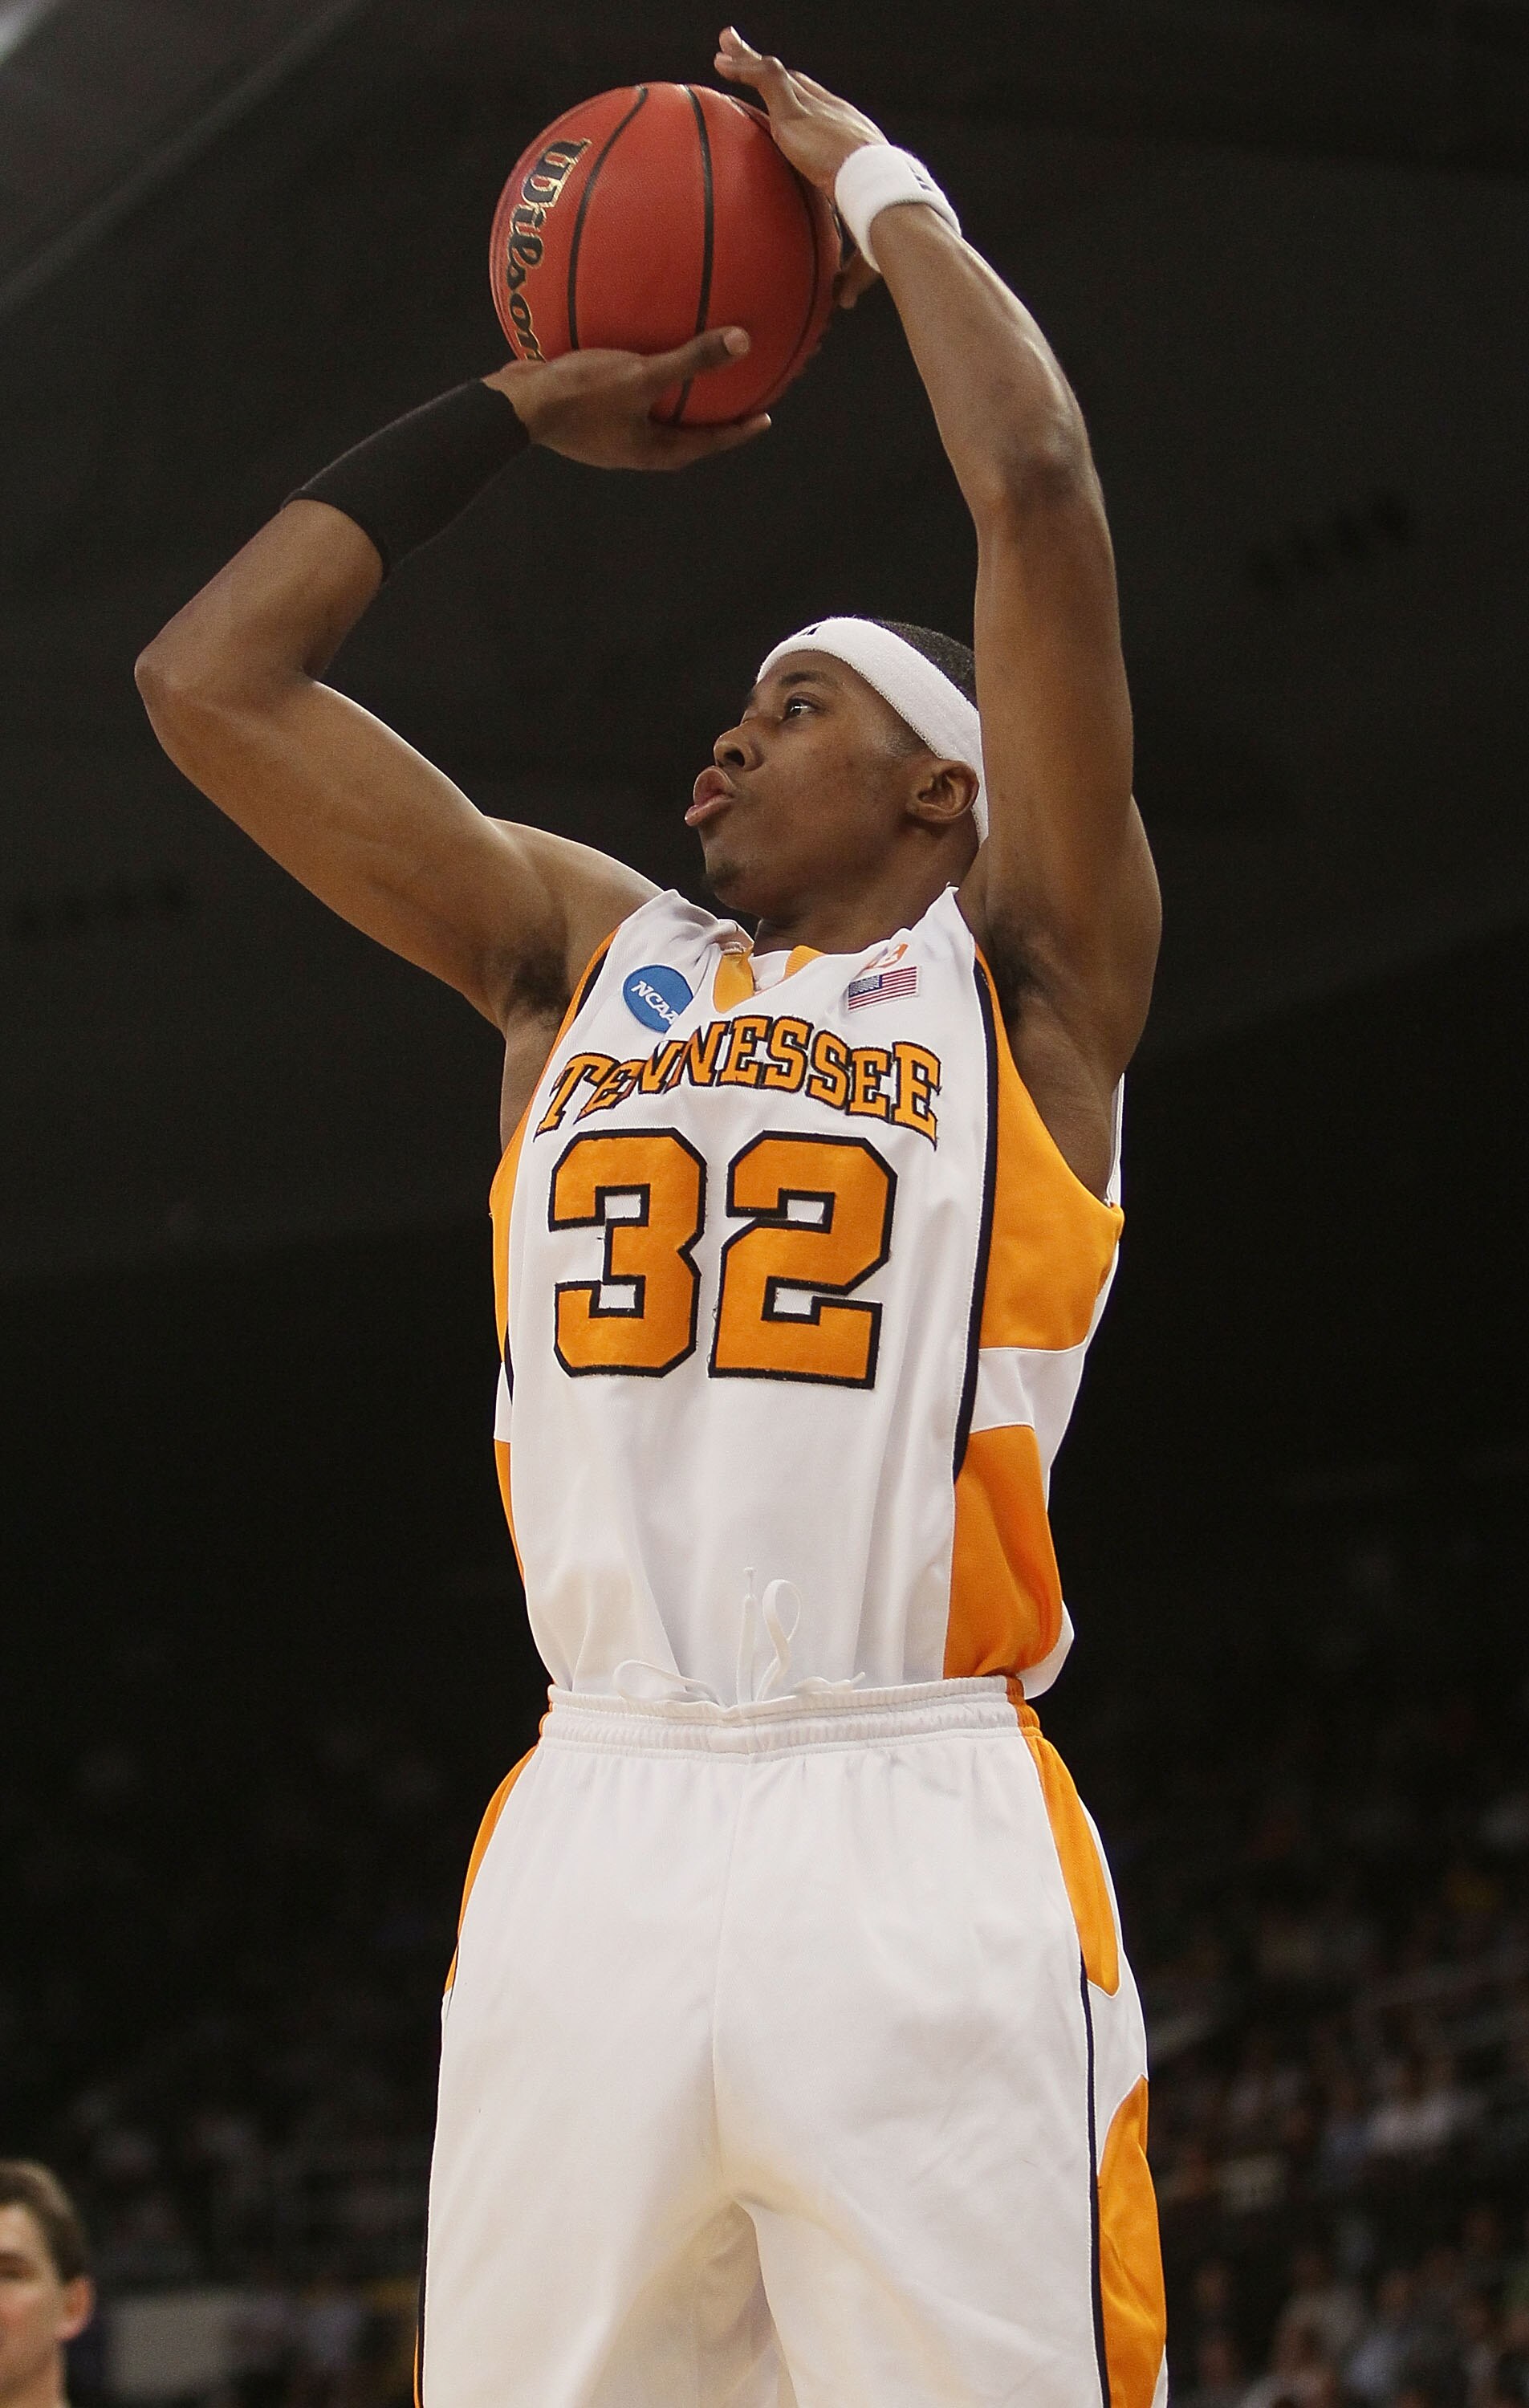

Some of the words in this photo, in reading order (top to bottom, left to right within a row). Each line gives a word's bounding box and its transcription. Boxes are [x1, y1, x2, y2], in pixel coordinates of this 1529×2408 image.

[630, 980, 679, 1025] NCAA
[533, 1015, 942, 1151] TENNESSEE
[548, 1128, 898, 1389] 32
